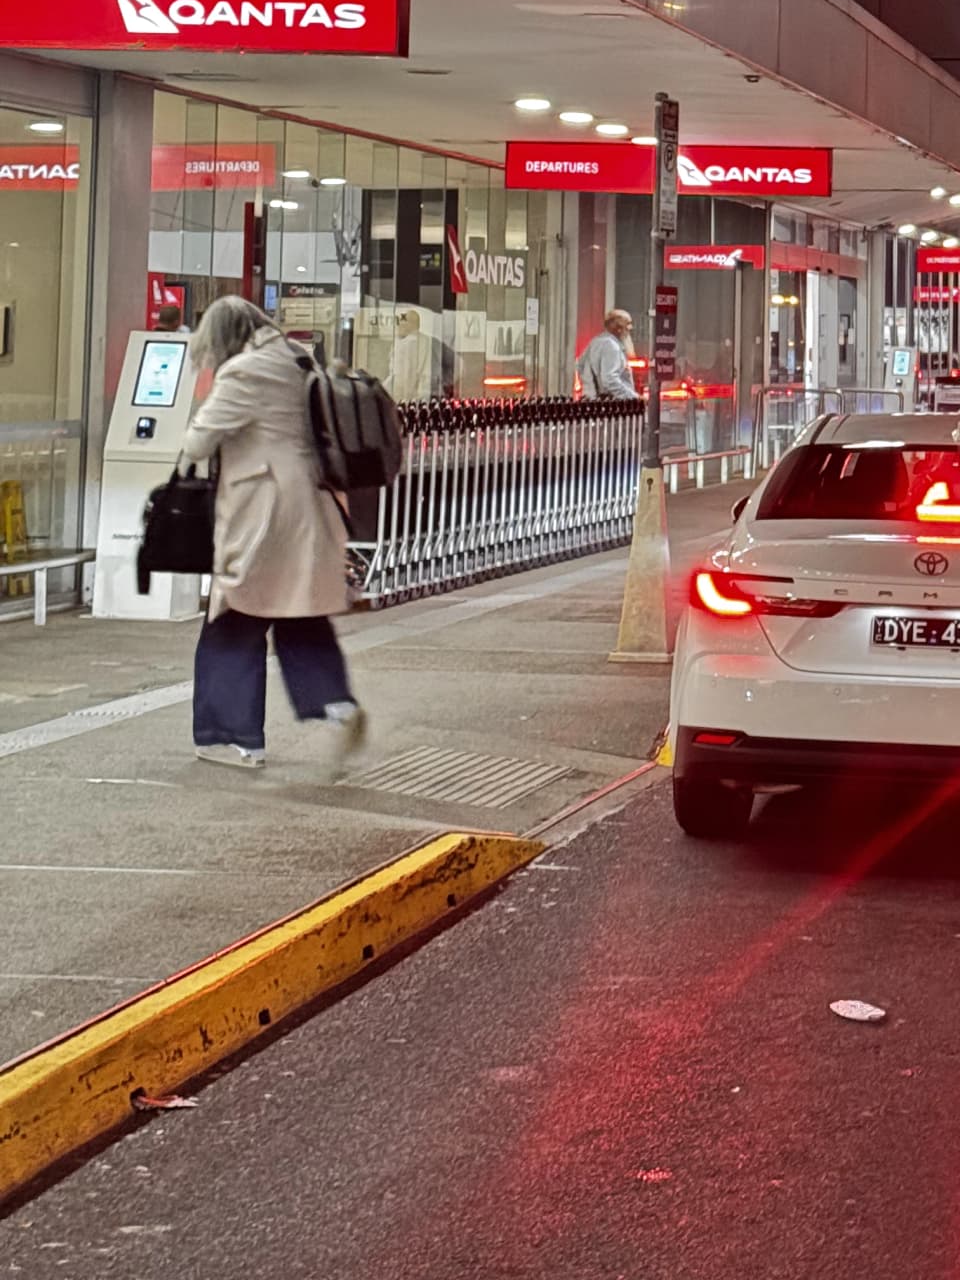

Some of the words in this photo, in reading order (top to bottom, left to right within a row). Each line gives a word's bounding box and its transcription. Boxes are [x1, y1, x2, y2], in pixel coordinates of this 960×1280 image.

[525, 160, 599, 175] DEPARTURES
[704, 166, 813, 184] QANTAS
[465, 249, 525, 288] QANTAS
[883, 619, 928, 644] DYE
